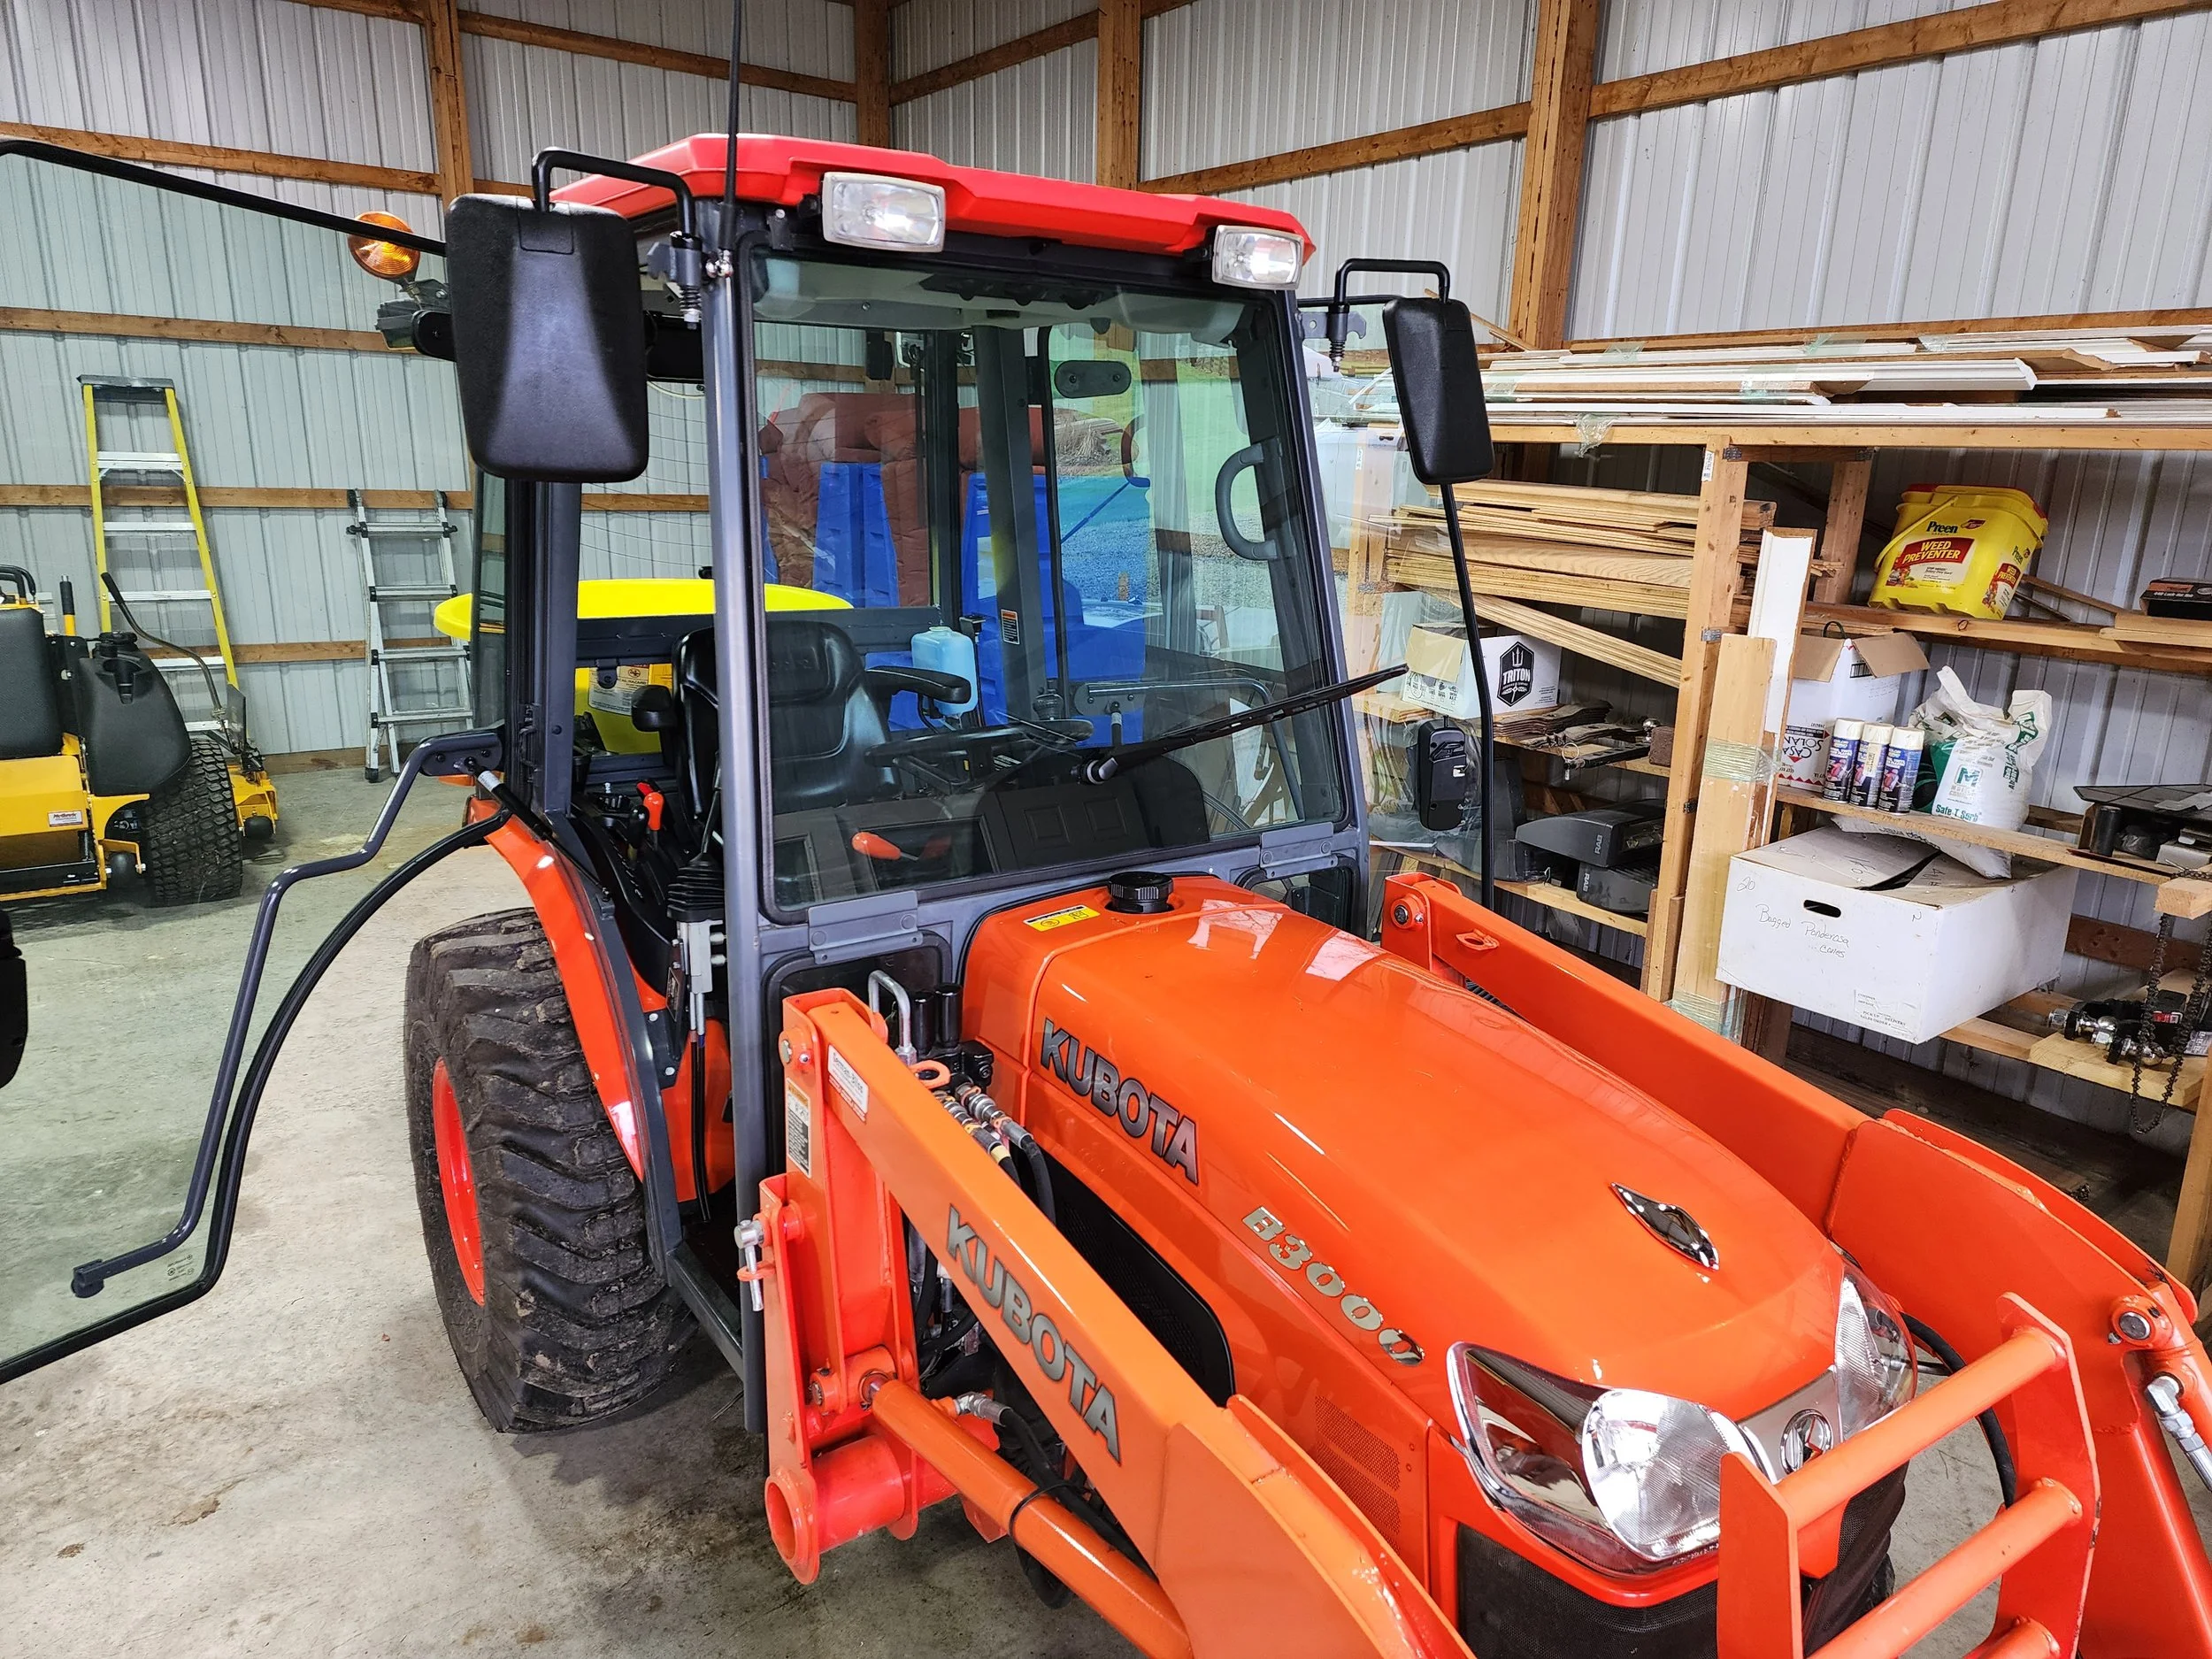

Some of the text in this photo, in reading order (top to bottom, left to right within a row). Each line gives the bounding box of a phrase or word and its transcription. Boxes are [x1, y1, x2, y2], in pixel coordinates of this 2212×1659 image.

[1926, 520, 1958, 534] Preen
[1920, 541, 1952, 552] WEED
[1902, 549, 1961, 565] PREVENTER
[1502, 667, 1531, 685] TRITON
[1784, 736, 1824, 751] SOLAN
[1783, 747, 1812, 758] CASA
[1935, 804, 1979, 822] Safe T Sorb
[1736, 877, 1755, 892] 20
[1755, 903, 1792, 928] Bagged
[1801, 920, 1849, 948] Ponderosa
[1885, 1017, 1906, 1026] DELIVERY
[1040, 1017, 1199, 1186] KUBOTA
[1241, 1206, 1425, 1366] B3000
[947, 1203, 1121, 1466] KUBOTA
